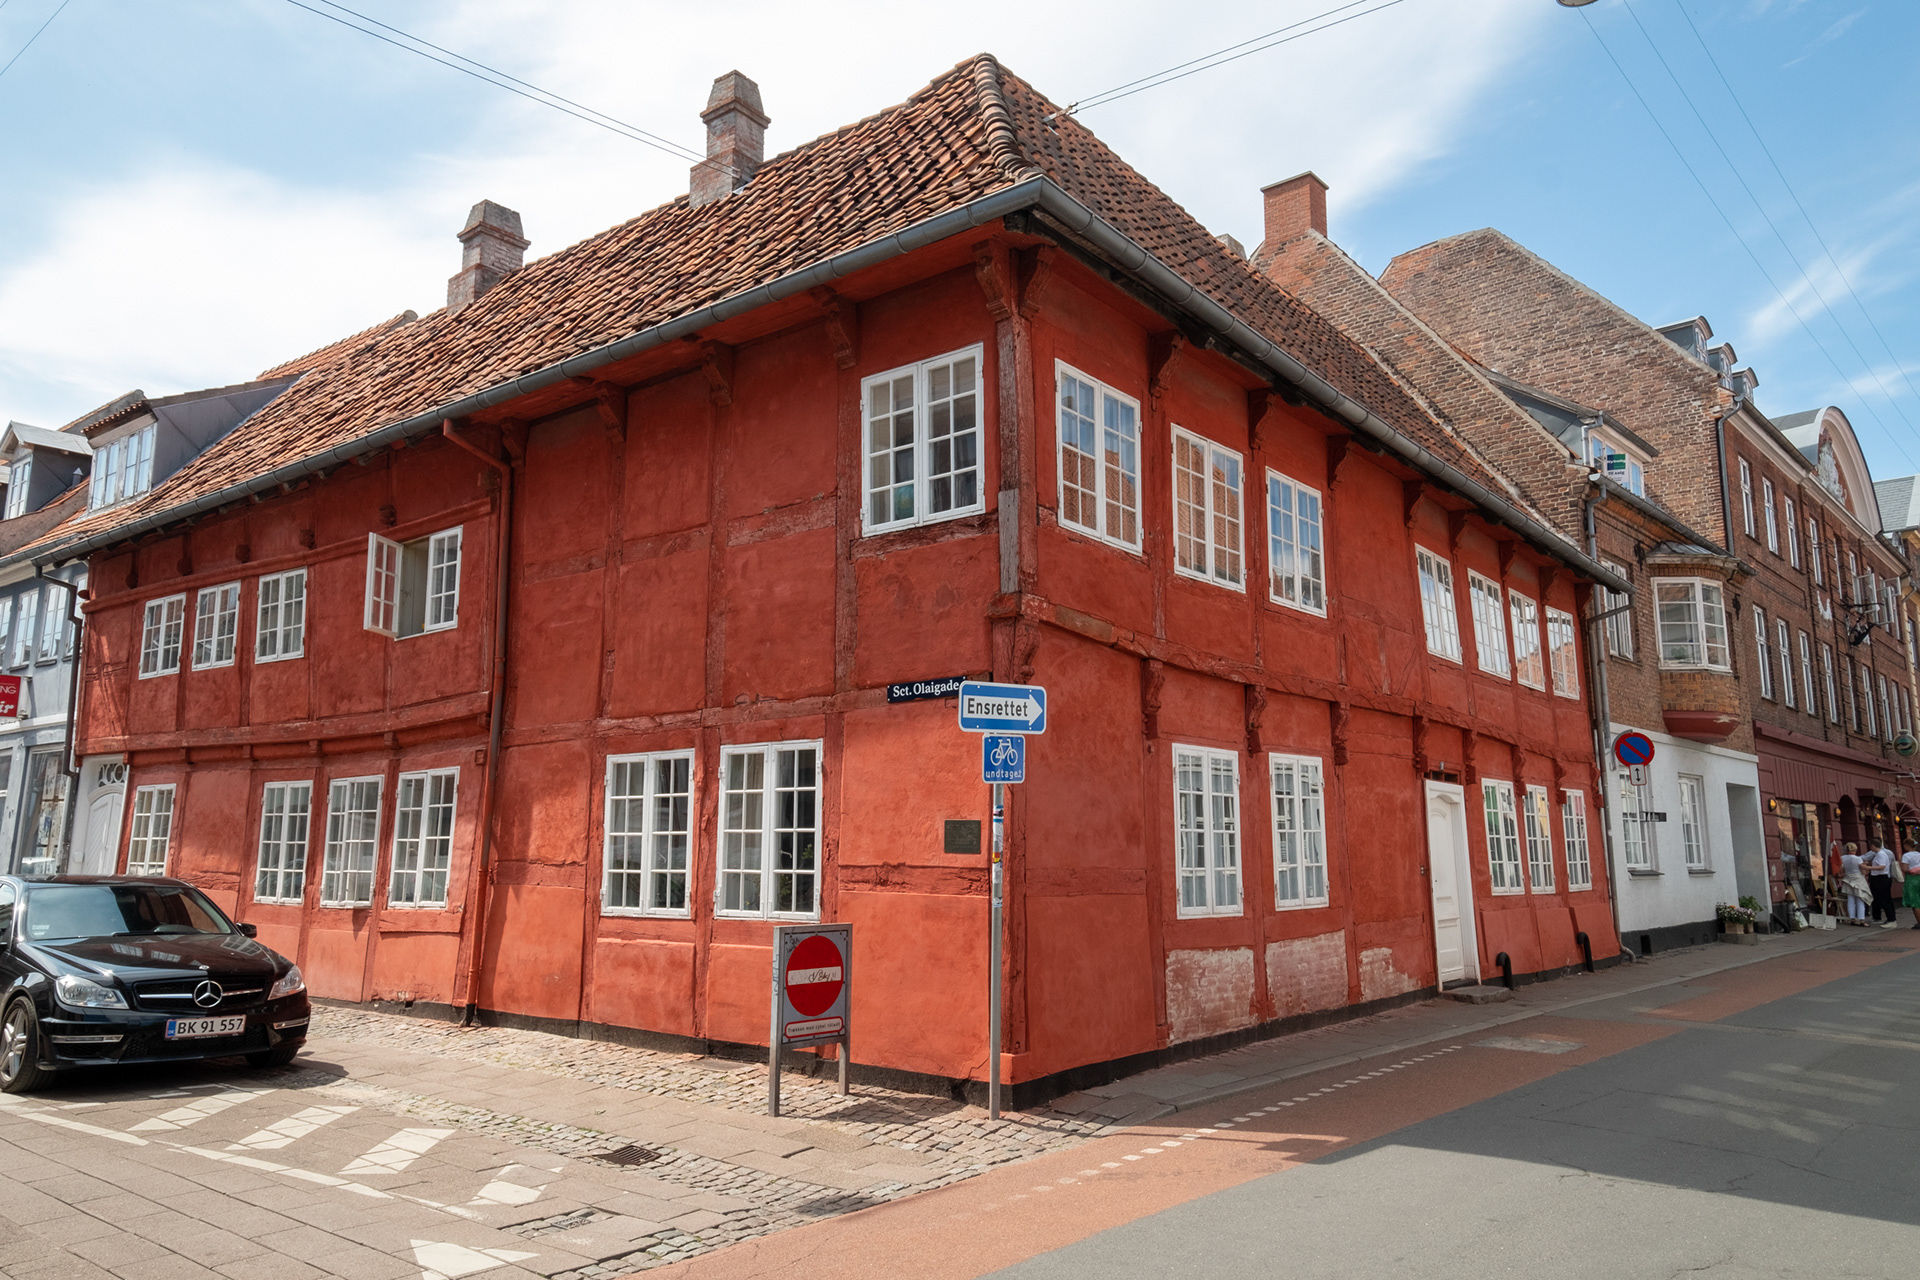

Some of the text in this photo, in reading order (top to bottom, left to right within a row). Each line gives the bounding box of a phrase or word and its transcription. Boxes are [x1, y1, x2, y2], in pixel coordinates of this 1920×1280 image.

[893, 679, 960, 697] Sct. Olaigade
[967, 697, 1028, 717] Ensrettet
[985, 769, 1022, 780] undtaget
[177, 1018, 244, 1035] BK 91 557
